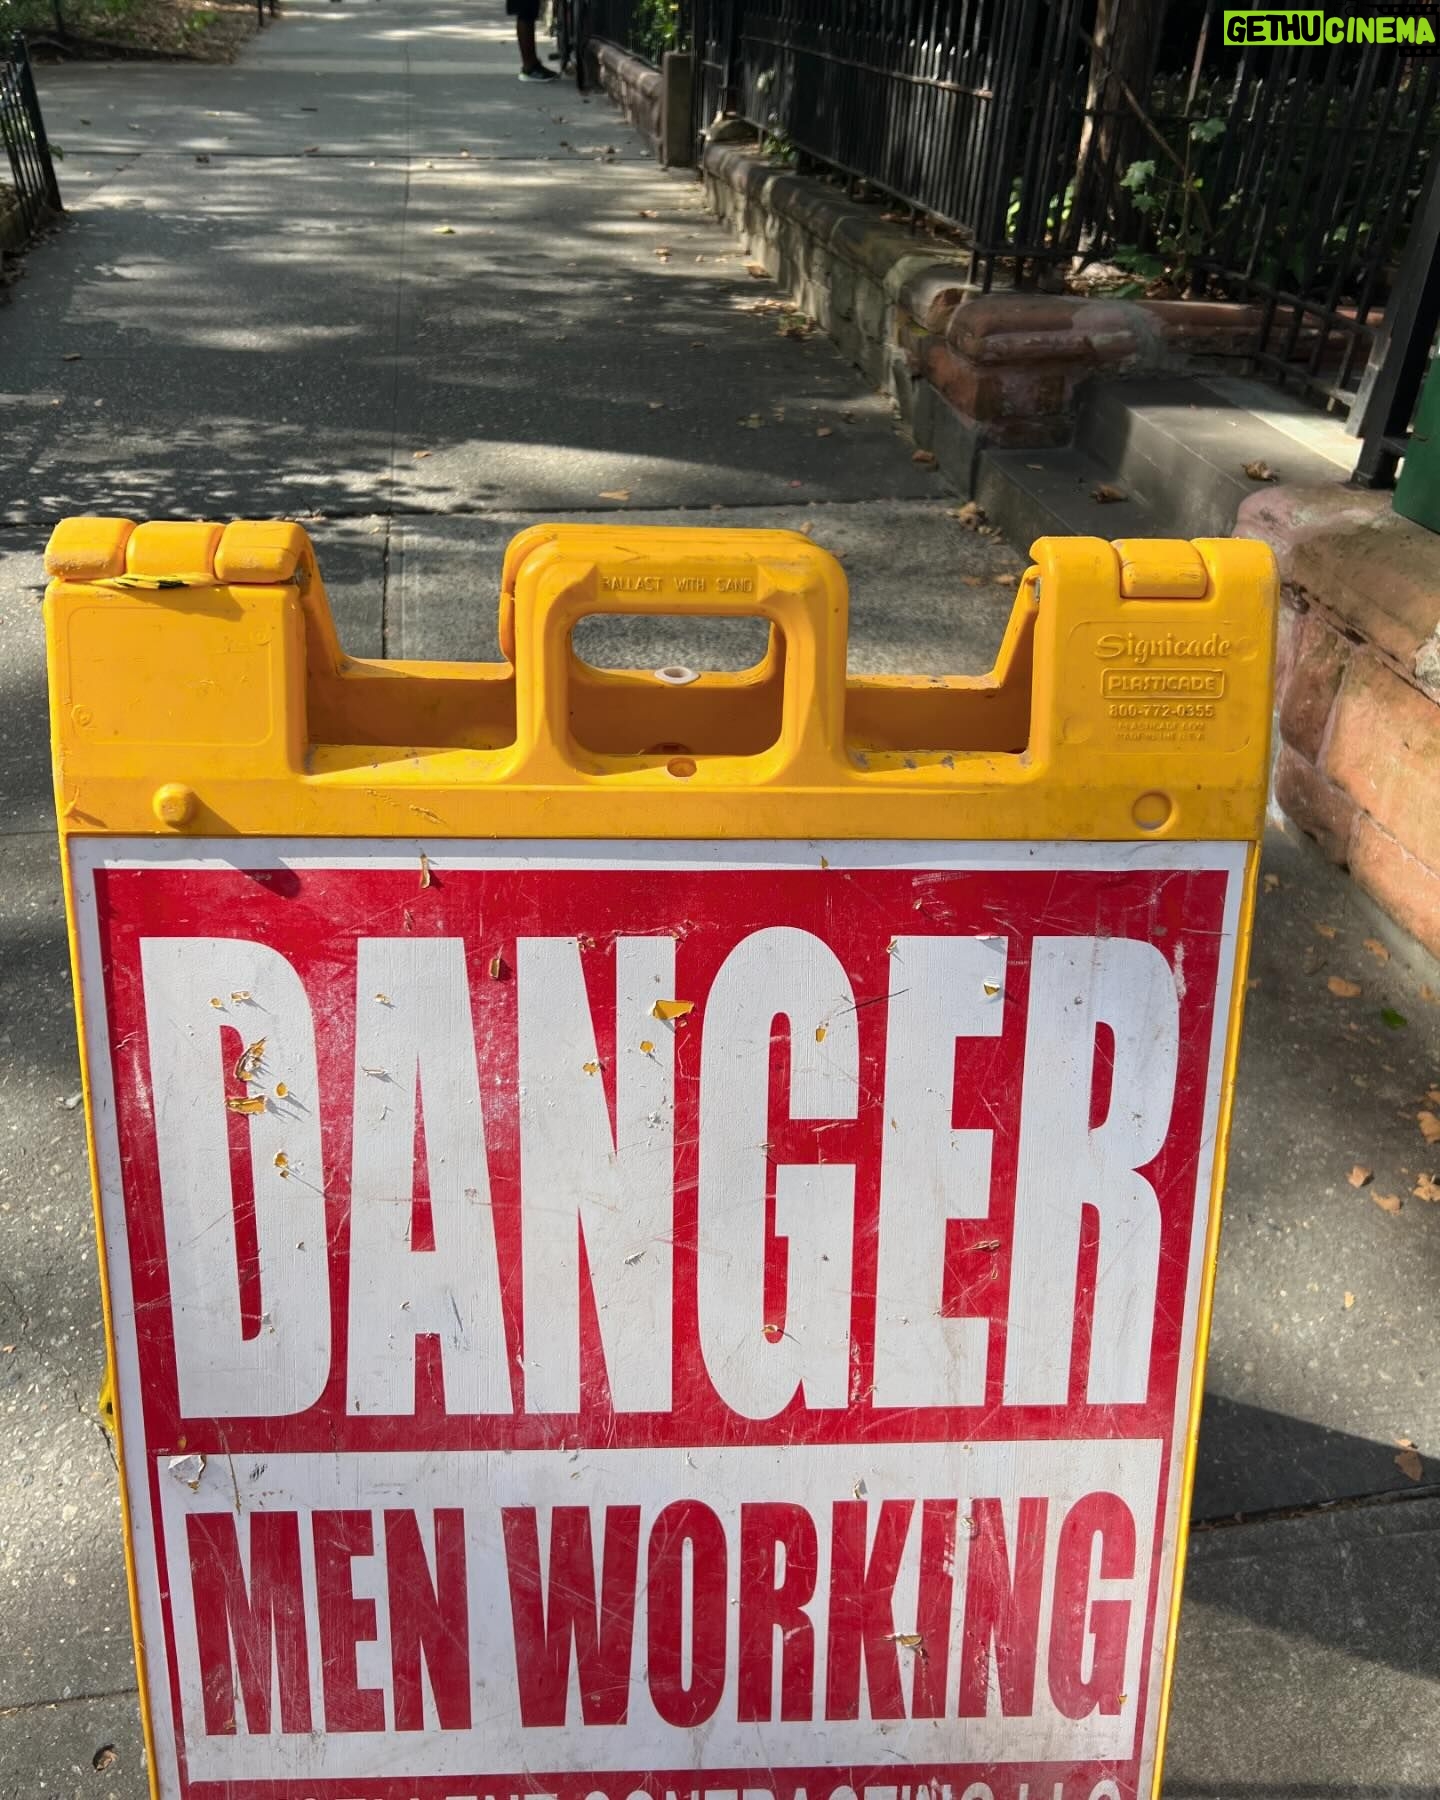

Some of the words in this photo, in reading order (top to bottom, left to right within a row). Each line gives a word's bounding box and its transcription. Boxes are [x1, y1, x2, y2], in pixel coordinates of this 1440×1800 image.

[600, 576, 663, 592] BALLAST
[674, 576, 705, 592] WITH
[716, 577, 753, 593] SAND
[1094, 632, 1232, 663] Signicade
[1108, 676, 1215, 691] PLASTICADE
[1108, 704, 1214, 718] 800-772-0355
[139, 926, 1180, 1420] DANGER
[187, 1507, 472, 1735] MEN
[502, 1491, 1138, 1732] WORKING
